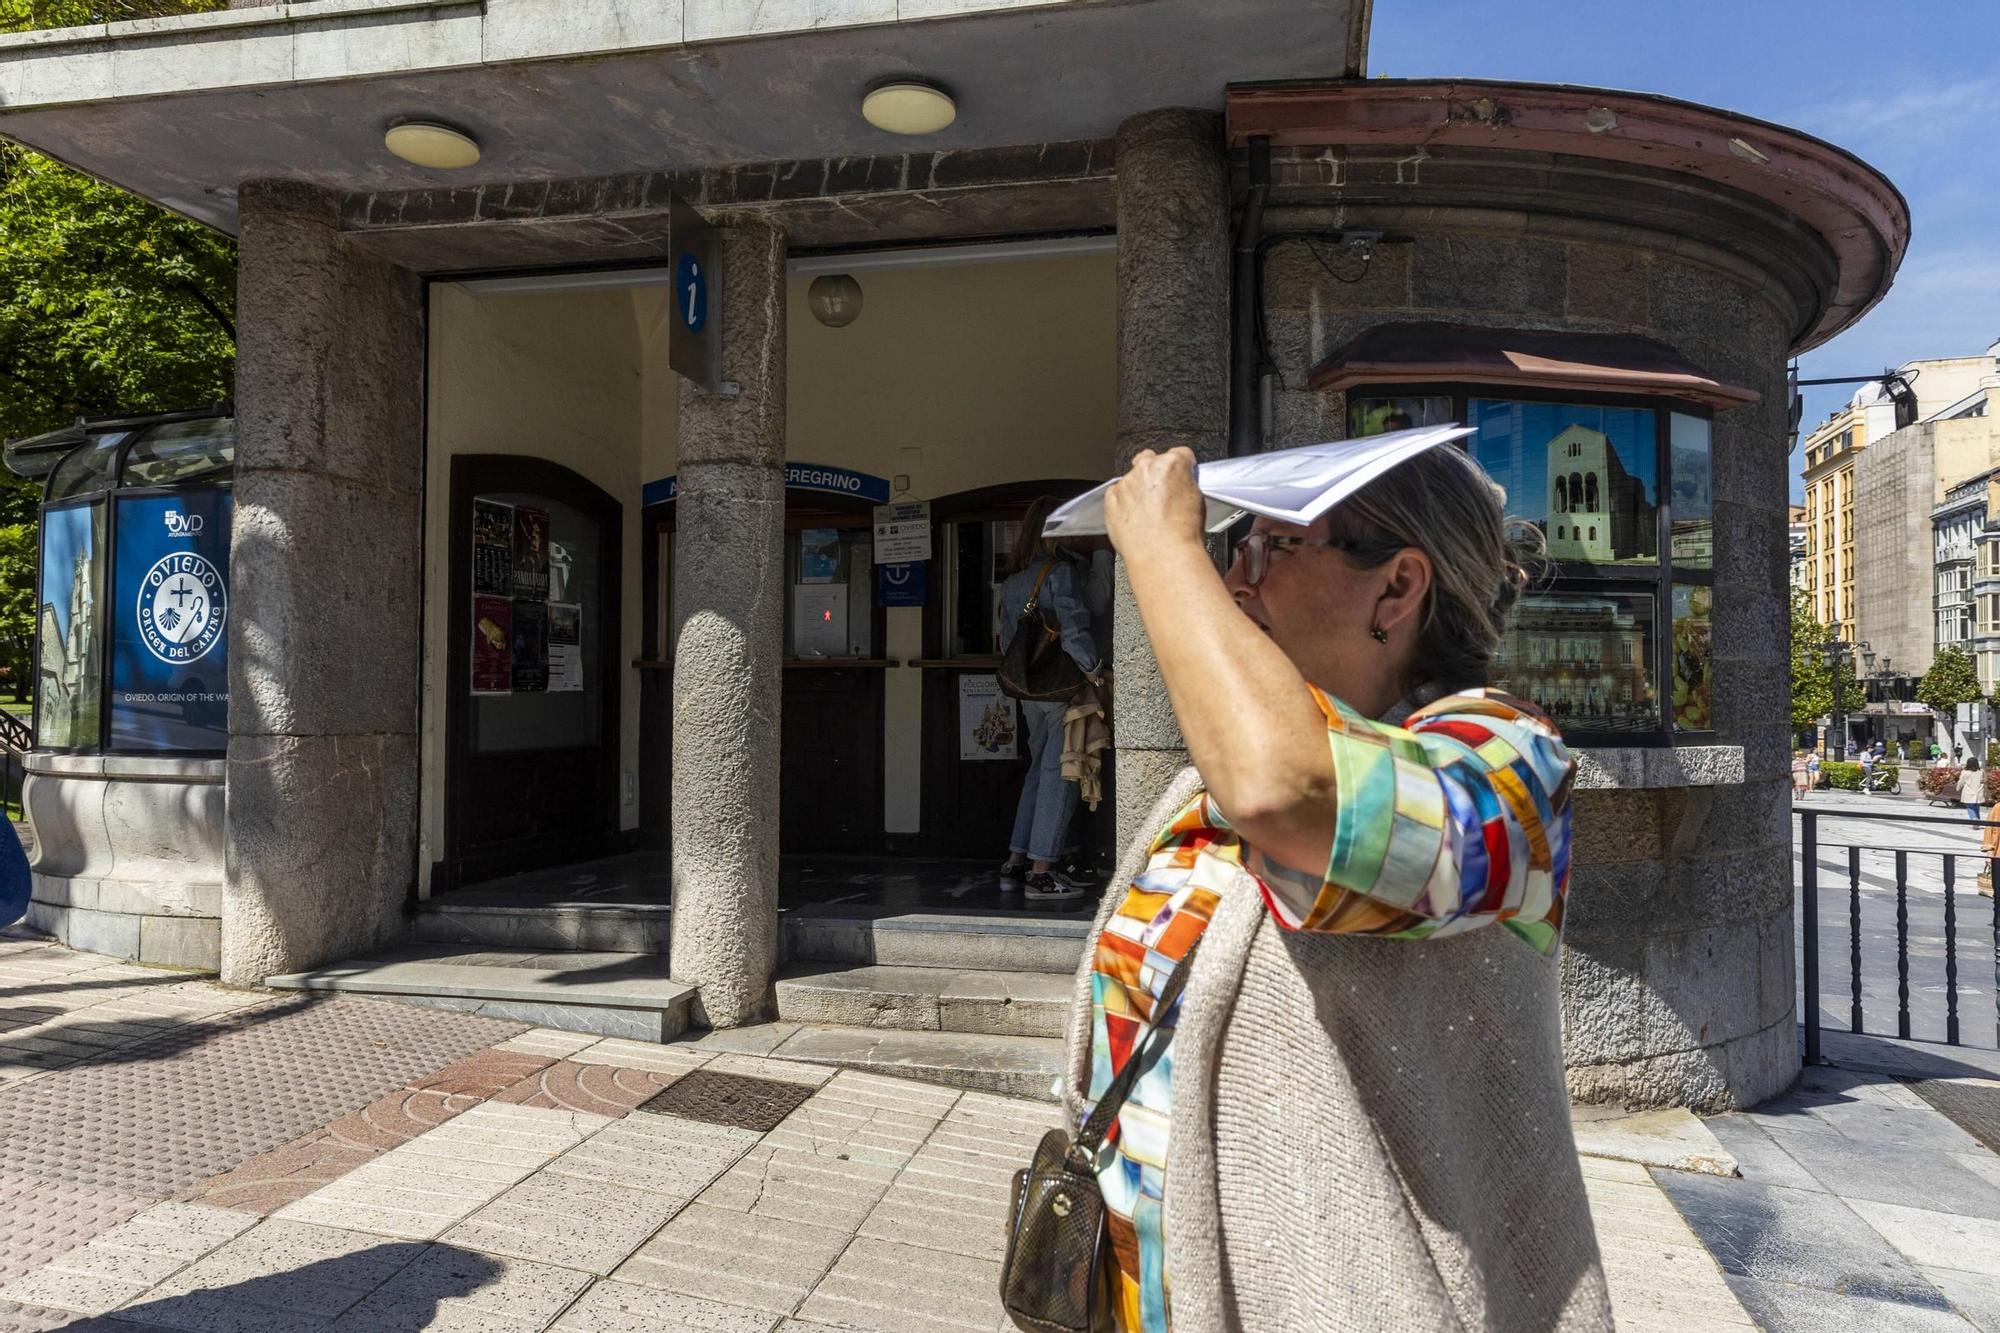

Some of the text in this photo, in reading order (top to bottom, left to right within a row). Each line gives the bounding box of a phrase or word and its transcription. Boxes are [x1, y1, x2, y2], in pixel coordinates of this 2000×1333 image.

[168, 514, 203, 532] OVD
[150, 556, 216, 587] OVIEDO
[143, 607, 221, 658] ORIGEN DEL CAMINO
[124, 692, 156, 703] OVIEDO,
[157, 692, 185, 702] ORIGIN
[186, 692, 197, 702] OF
[198, 692, 214, 702] THE
